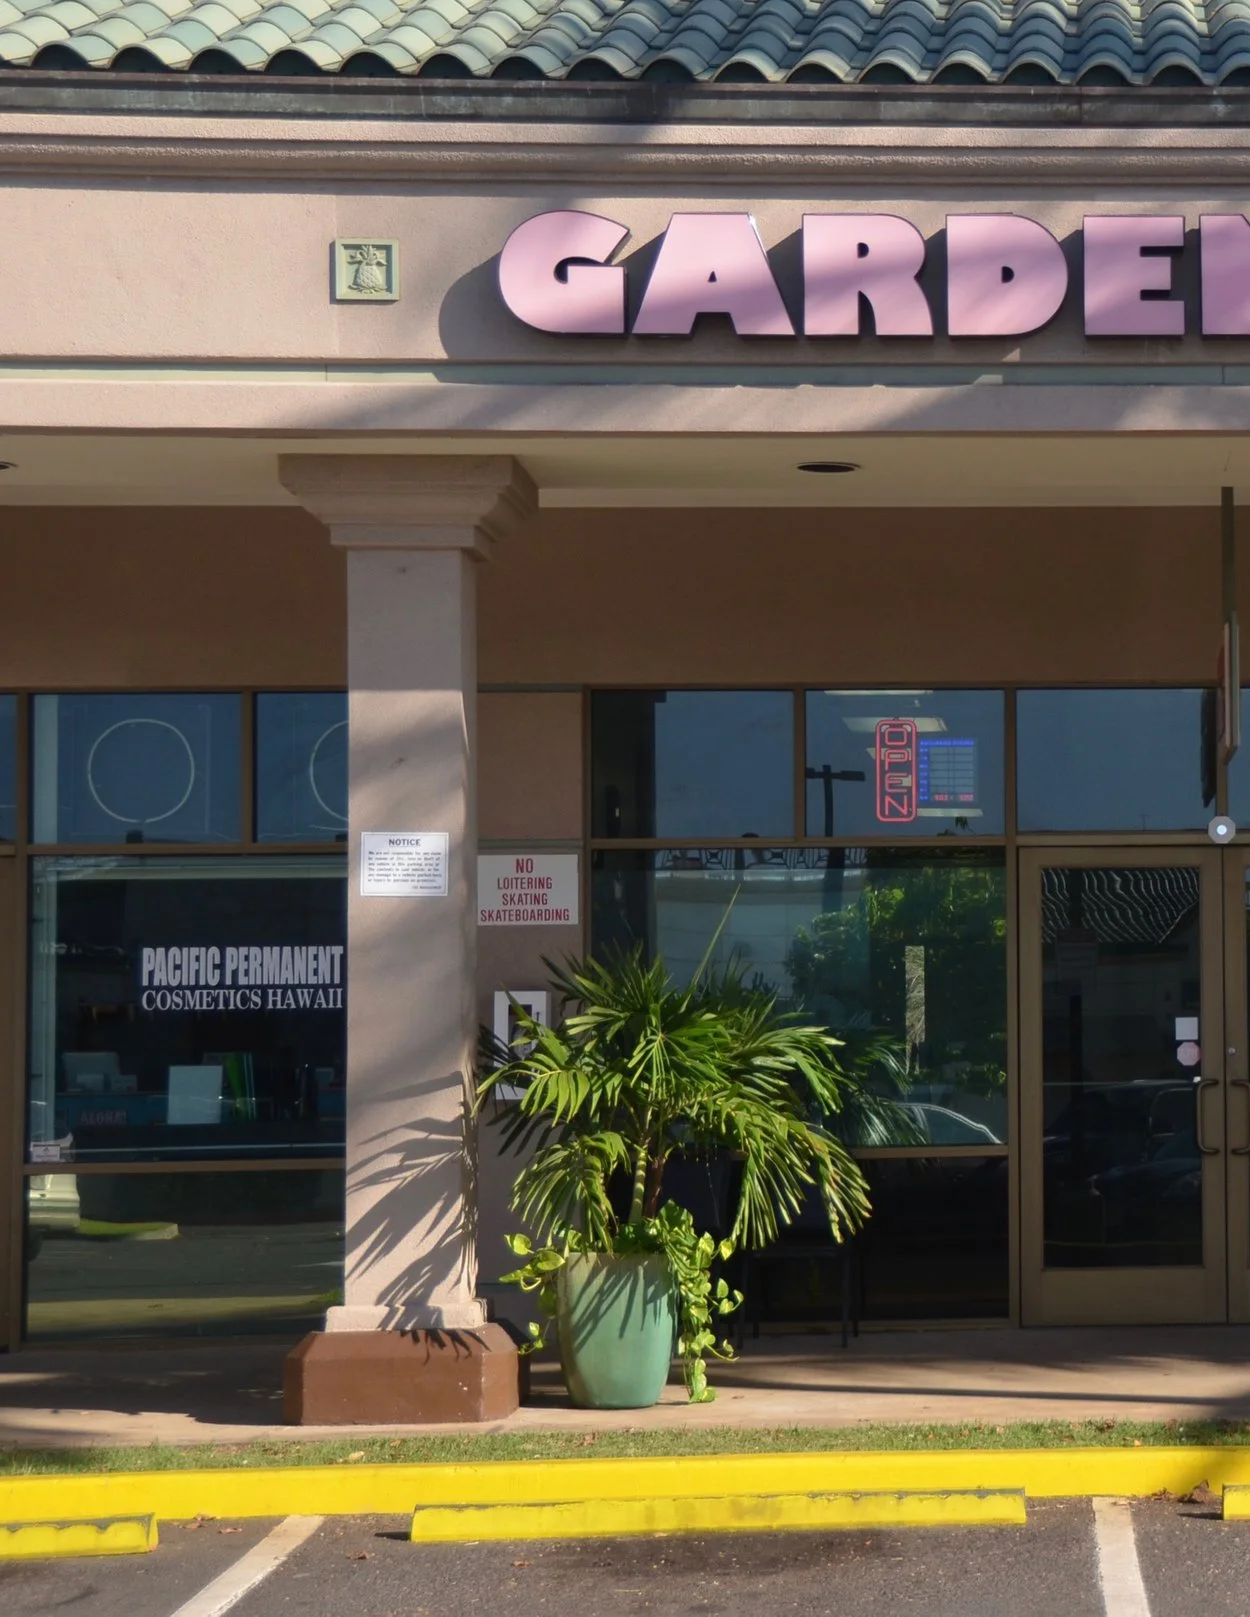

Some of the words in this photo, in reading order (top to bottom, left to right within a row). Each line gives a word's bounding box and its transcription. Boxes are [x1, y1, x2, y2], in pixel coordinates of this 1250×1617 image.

[885, 727, 909, 816] OPEN
[388, 838, 421, 847] NOTICE
[515, 858, 534, 874] NO
[497, 876, 553, 890] LOITERING
[502, 893, 548, 906] SKATING
[480, 908, 570, 922] SKATEBOARDING
[142, 946, 221, 986] PACIFIC
[225, 945, 344, 986] PERMANENT
[142, 988, 262, 1011] COSMETICS
[266, 988, 343, 1009] HAWAII
